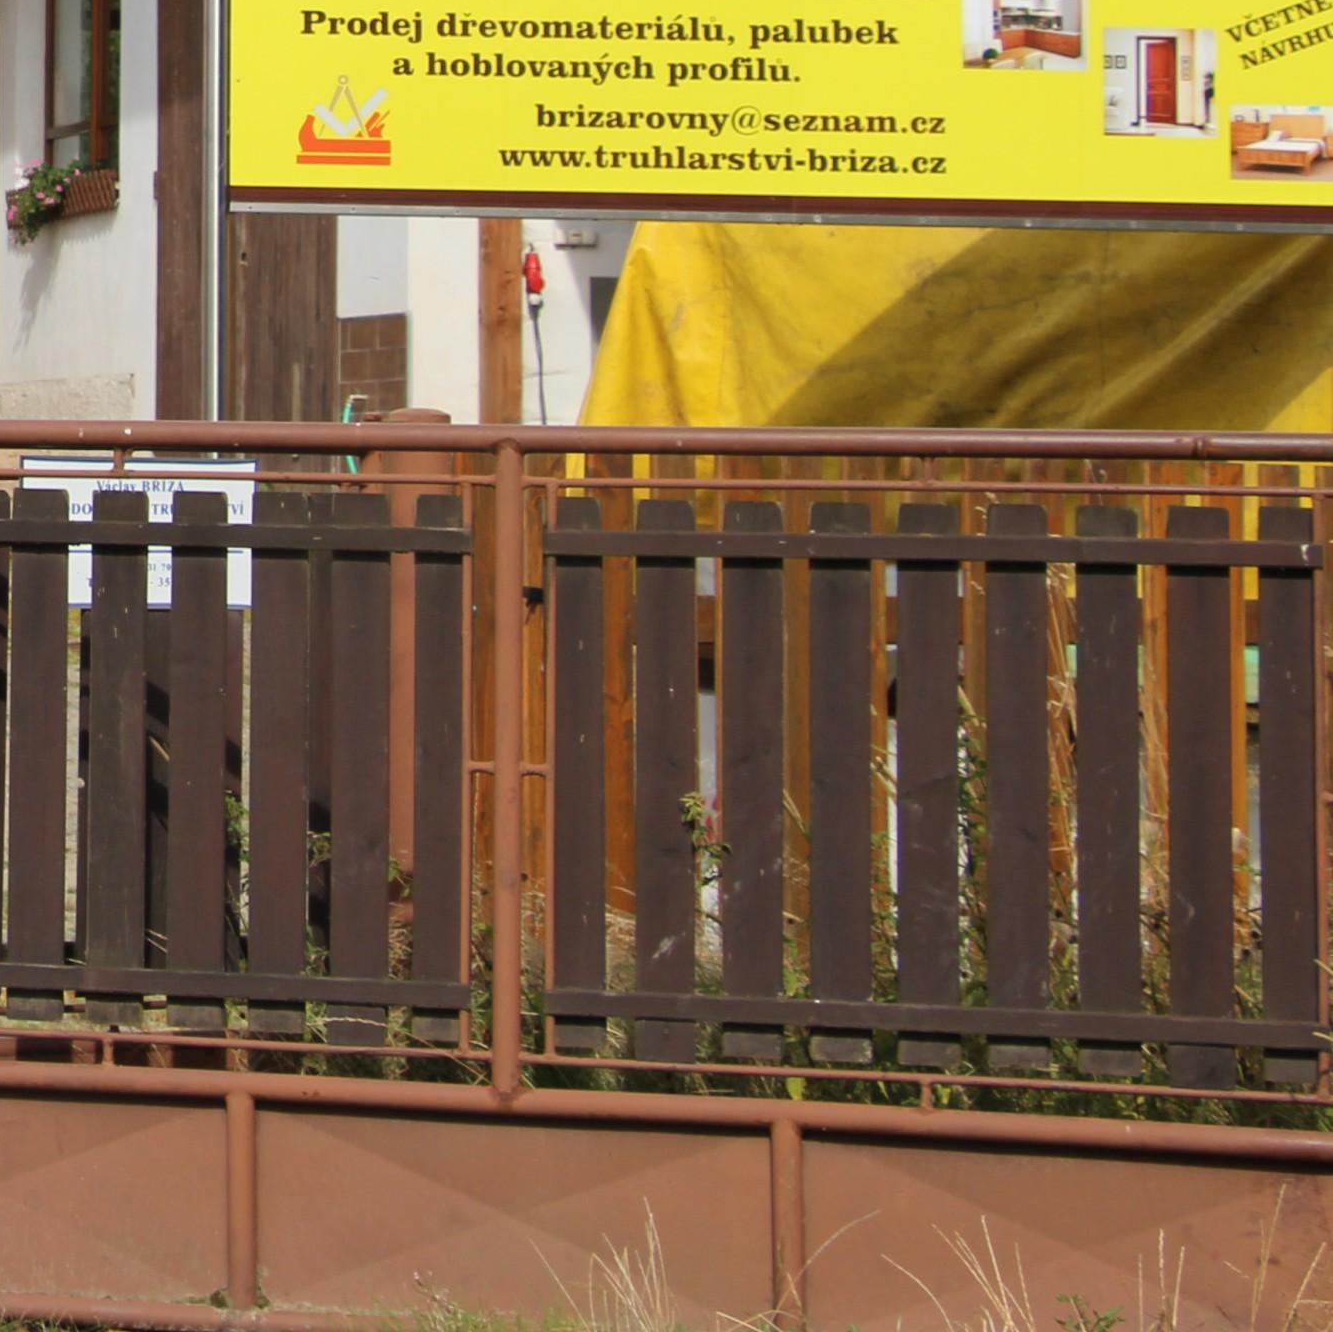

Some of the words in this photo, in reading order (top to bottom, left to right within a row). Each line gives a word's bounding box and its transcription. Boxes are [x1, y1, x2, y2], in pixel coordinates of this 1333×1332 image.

[300, 10, 424, 43] Prodej
[749, 18, 899, 49] palubek
[392, 56, 414, 76] a
[426, 52, 654, 85] hoblovaných
[536, 104, 946, 136] brizarovny@seznam.cz
[499, 145, 948, 175] www.truhlarstvi-briza.cz
